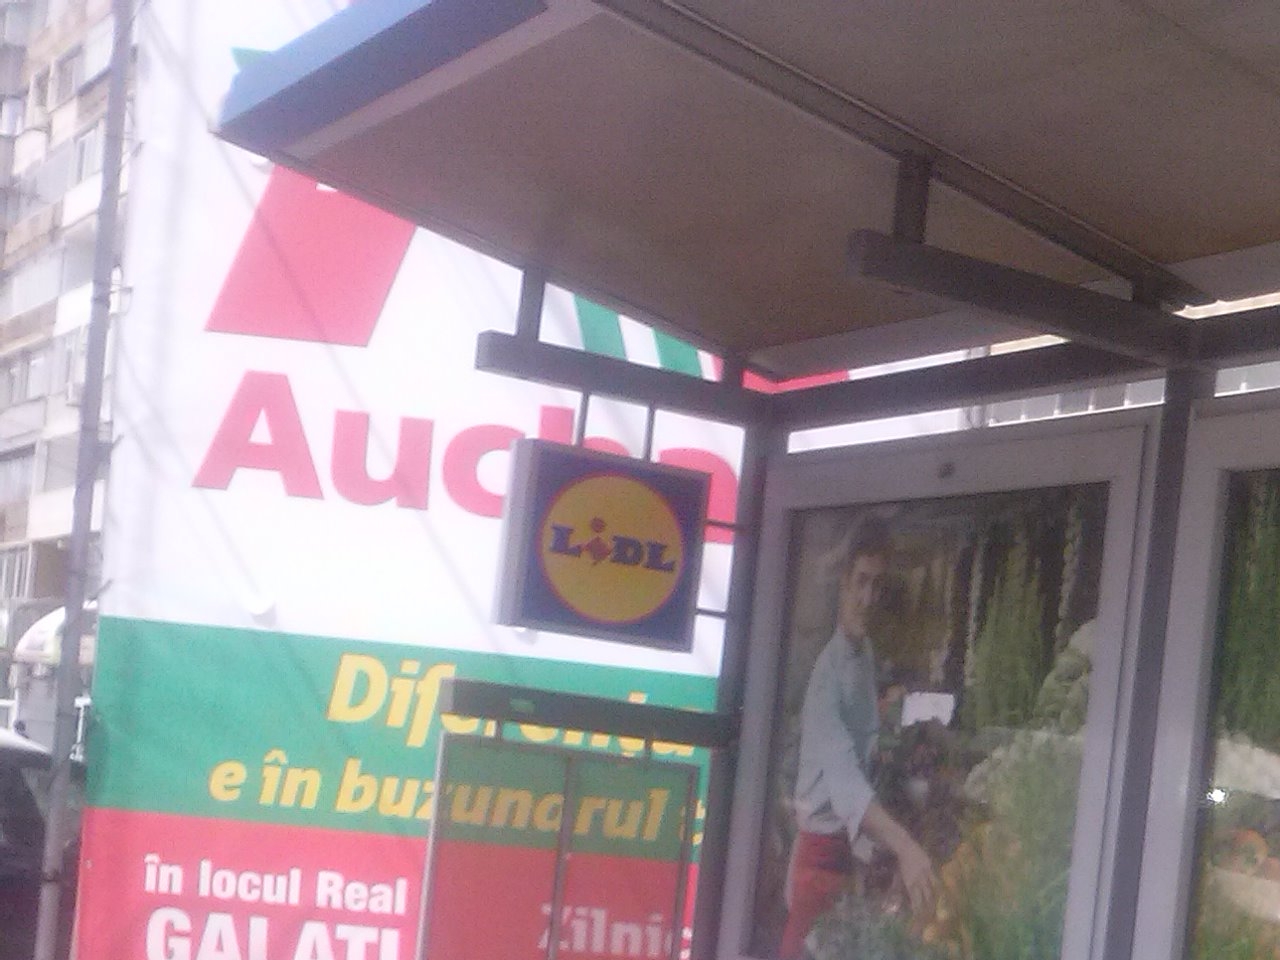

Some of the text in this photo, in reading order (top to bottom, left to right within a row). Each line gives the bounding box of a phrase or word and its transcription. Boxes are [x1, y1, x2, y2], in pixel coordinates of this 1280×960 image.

[208, 760, 247, 802] e
[258, 750, 322, 810] în
[144, 853, 408, 916] în locul Real
